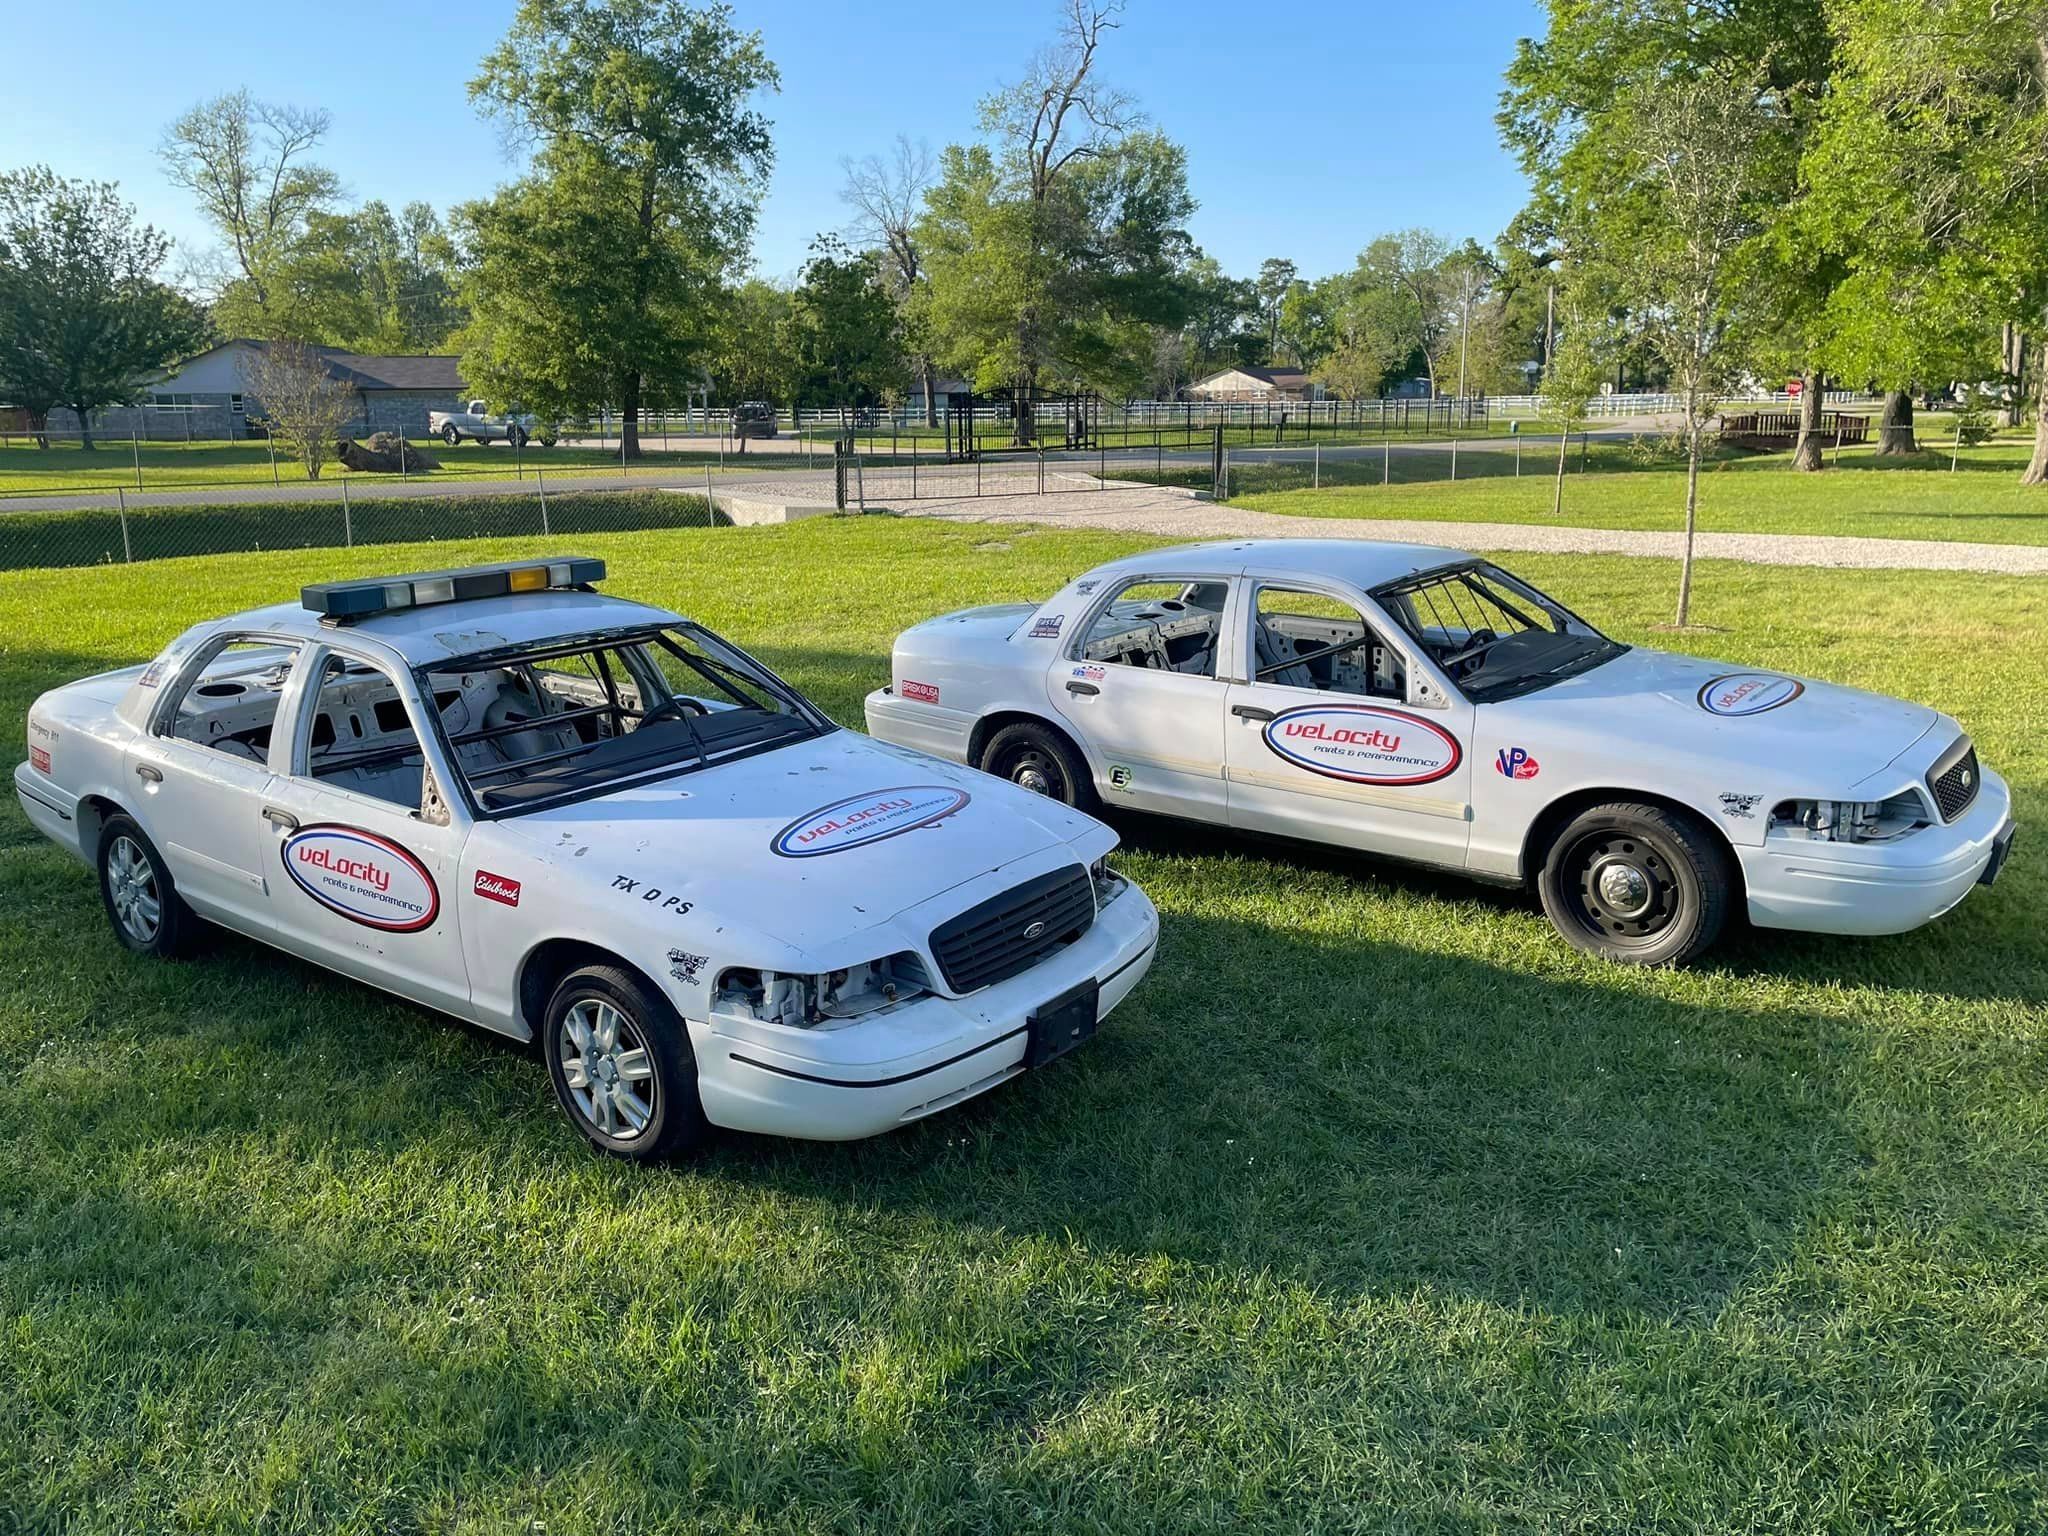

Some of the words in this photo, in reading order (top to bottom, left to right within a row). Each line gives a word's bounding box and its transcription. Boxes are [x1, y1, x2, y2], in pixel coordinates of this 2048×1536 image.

[1347, 748, 1355, 756] &
[1498, 747, 1528, 779] VP
[349, 884, 356, 892] &
[475, 876, 518, 901] Edelbrock
[611, 874, 641, 893] TX
